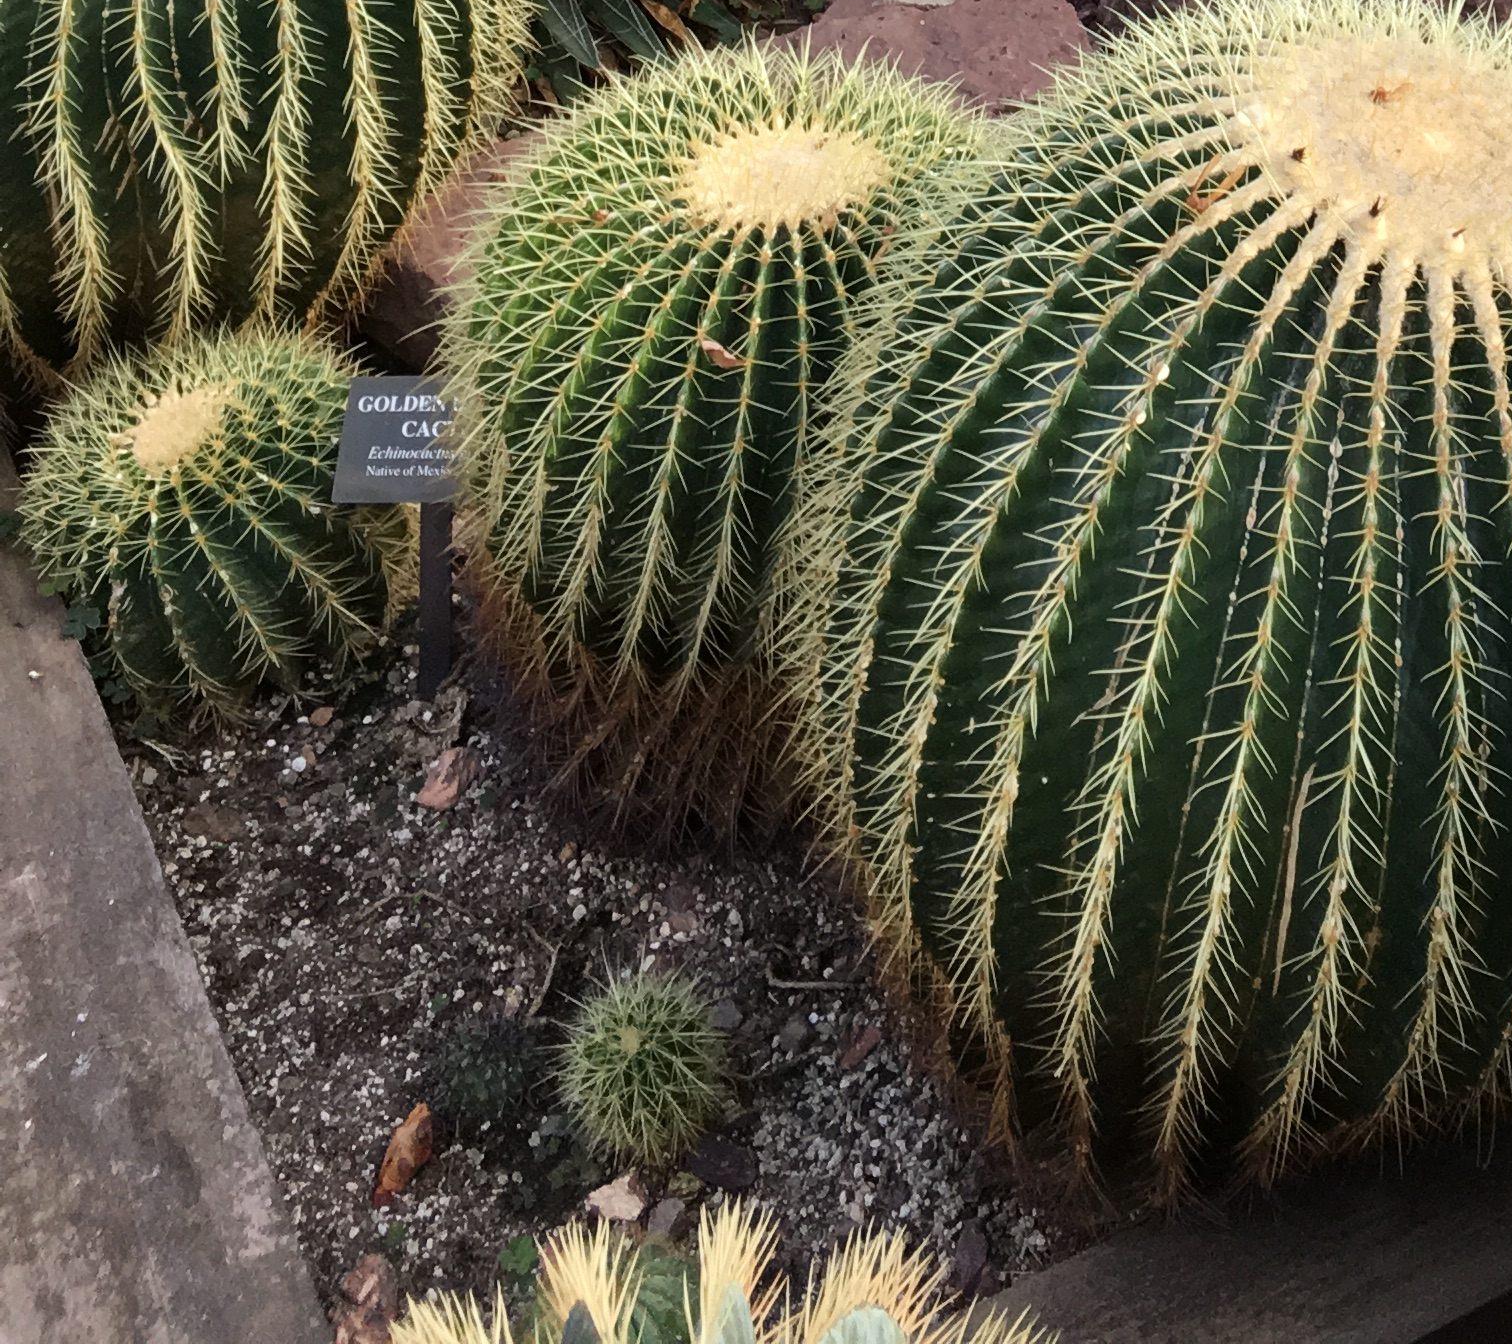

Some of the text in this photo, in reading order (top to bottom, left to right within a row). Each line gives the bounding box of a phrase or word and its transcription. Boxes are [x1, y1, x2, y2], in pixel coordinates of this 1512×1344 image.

[357, 394, 446, 413] GOLDEN
[365, 464, 401, 477] Native
[402, 464, 416, 477] of
